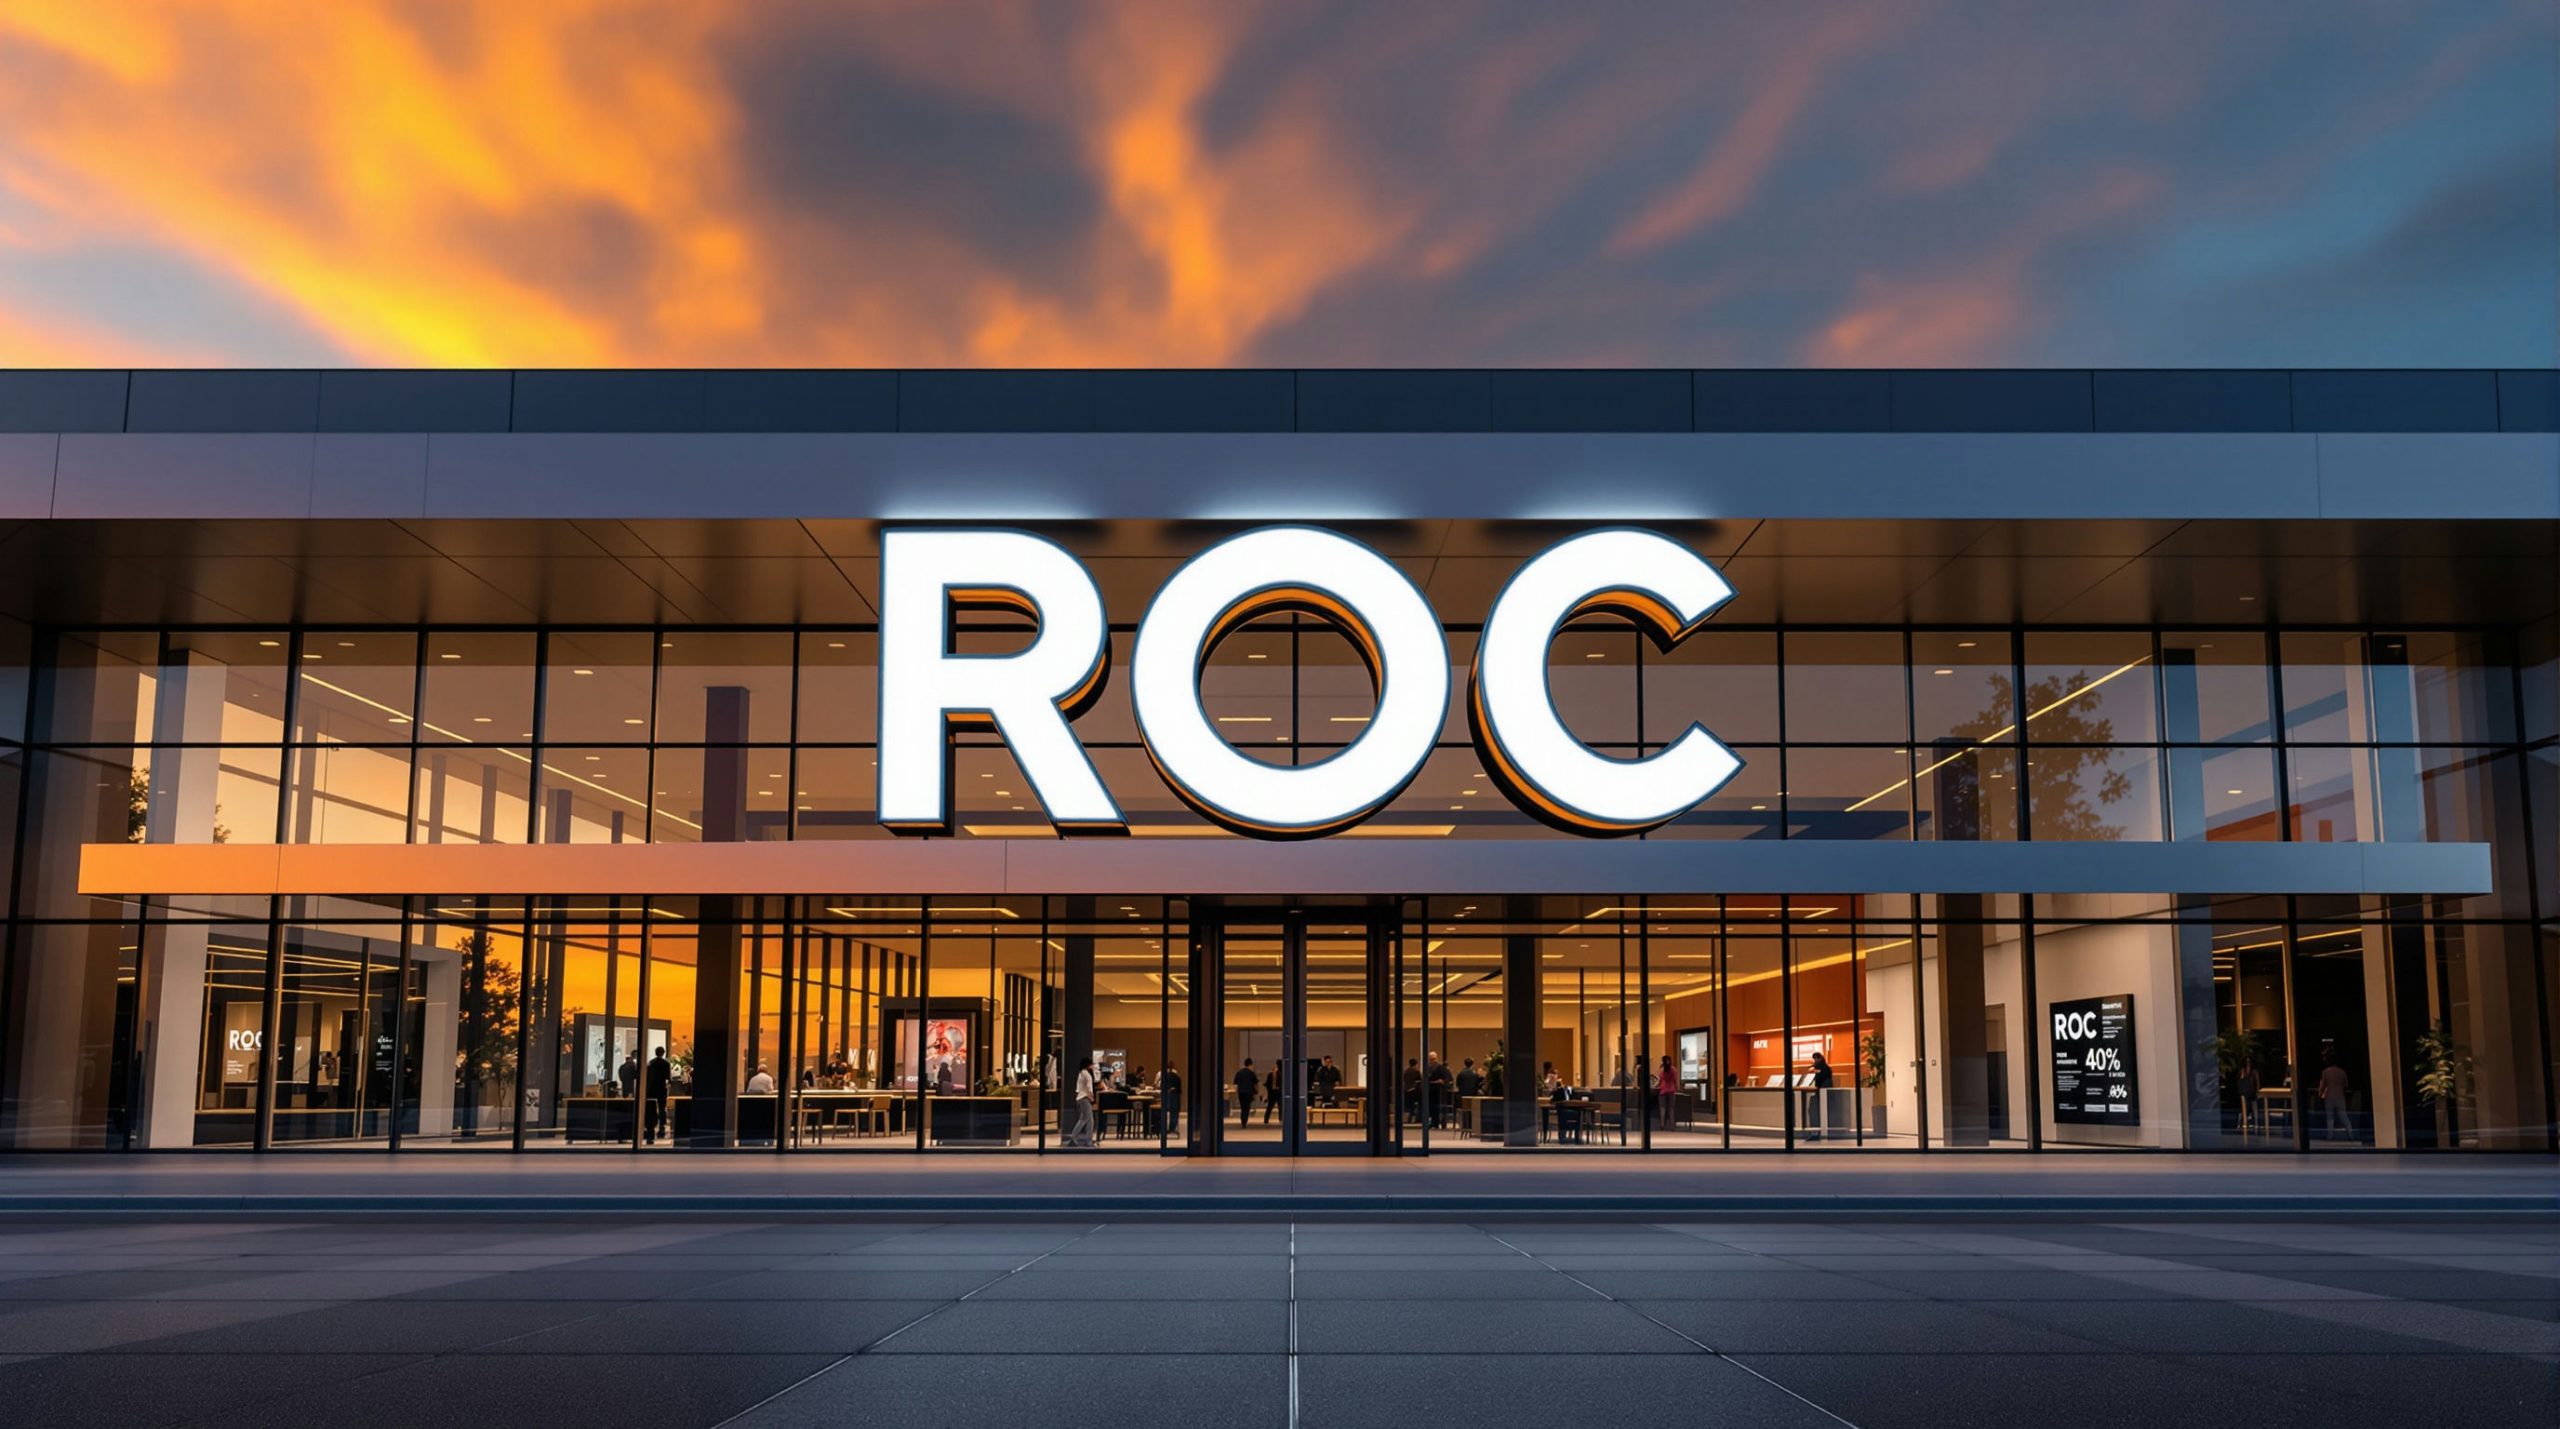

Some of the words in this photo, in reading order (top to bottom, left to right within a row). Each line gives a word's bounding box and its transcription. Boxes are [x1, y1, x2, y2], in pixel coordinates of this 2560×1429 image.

[877, 525, 1747, 836] ROC
[2054, 1011, 2097, 1040] ROC
[2085, 1048, 2121, 1071] 40%
